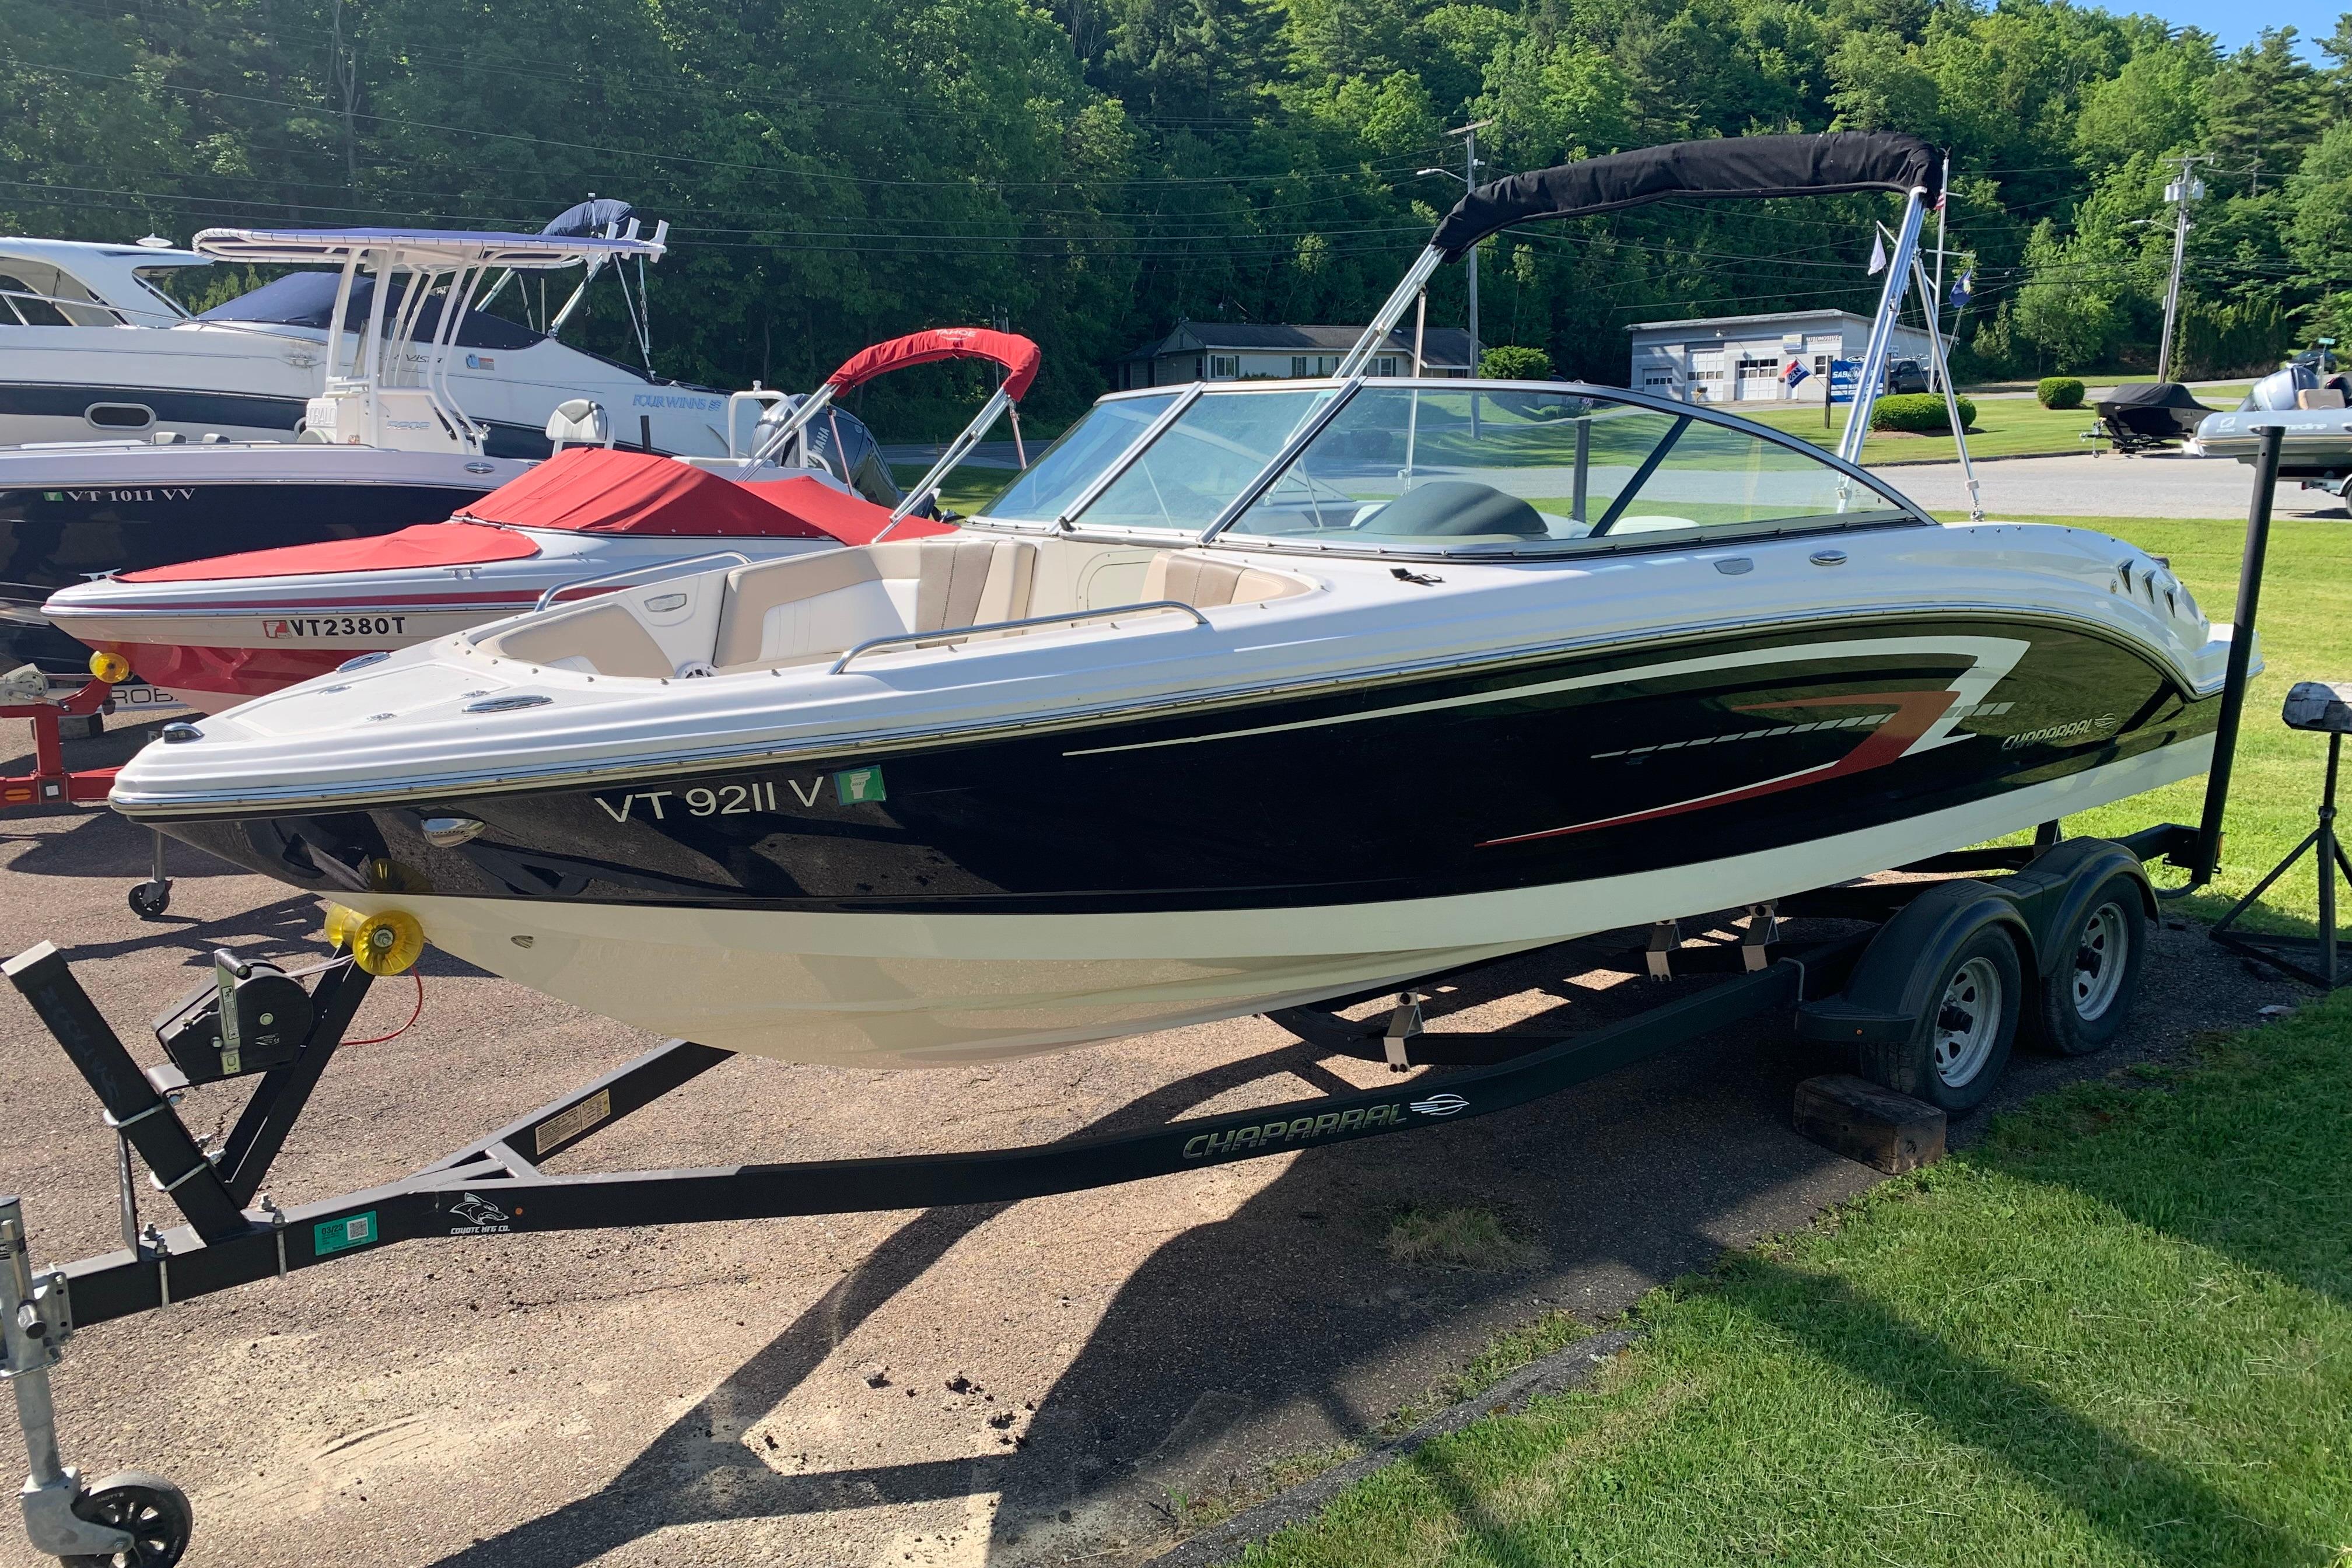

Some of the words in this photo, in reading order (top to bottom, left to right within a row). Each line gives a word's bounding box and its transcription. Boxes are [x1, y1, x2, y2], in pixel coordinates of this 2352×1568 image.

[935, 328, 977, 337] TAHOE
[633, 394, 664, 407] FOUR
[665, 396, 707, 410] WINNS
[66, 491, 101, 502] VT
[108, 489, 155, 502] 1011
[160, 488, 196, 501] VV
[290, 617, 405, 636] VT2380T
[2001, 718, 2093, 751] CHAPARRAL
[594, 790, 672, 822] VT
[685, 782, 776, 816] 9211
[788, 776, 824, 807] V
[1182, 1104, 1407, 1159] CHAPARRAL
[321, 1224, 344, 1235] 03/23
[450, 1227, 481, 1235] COYOTE
